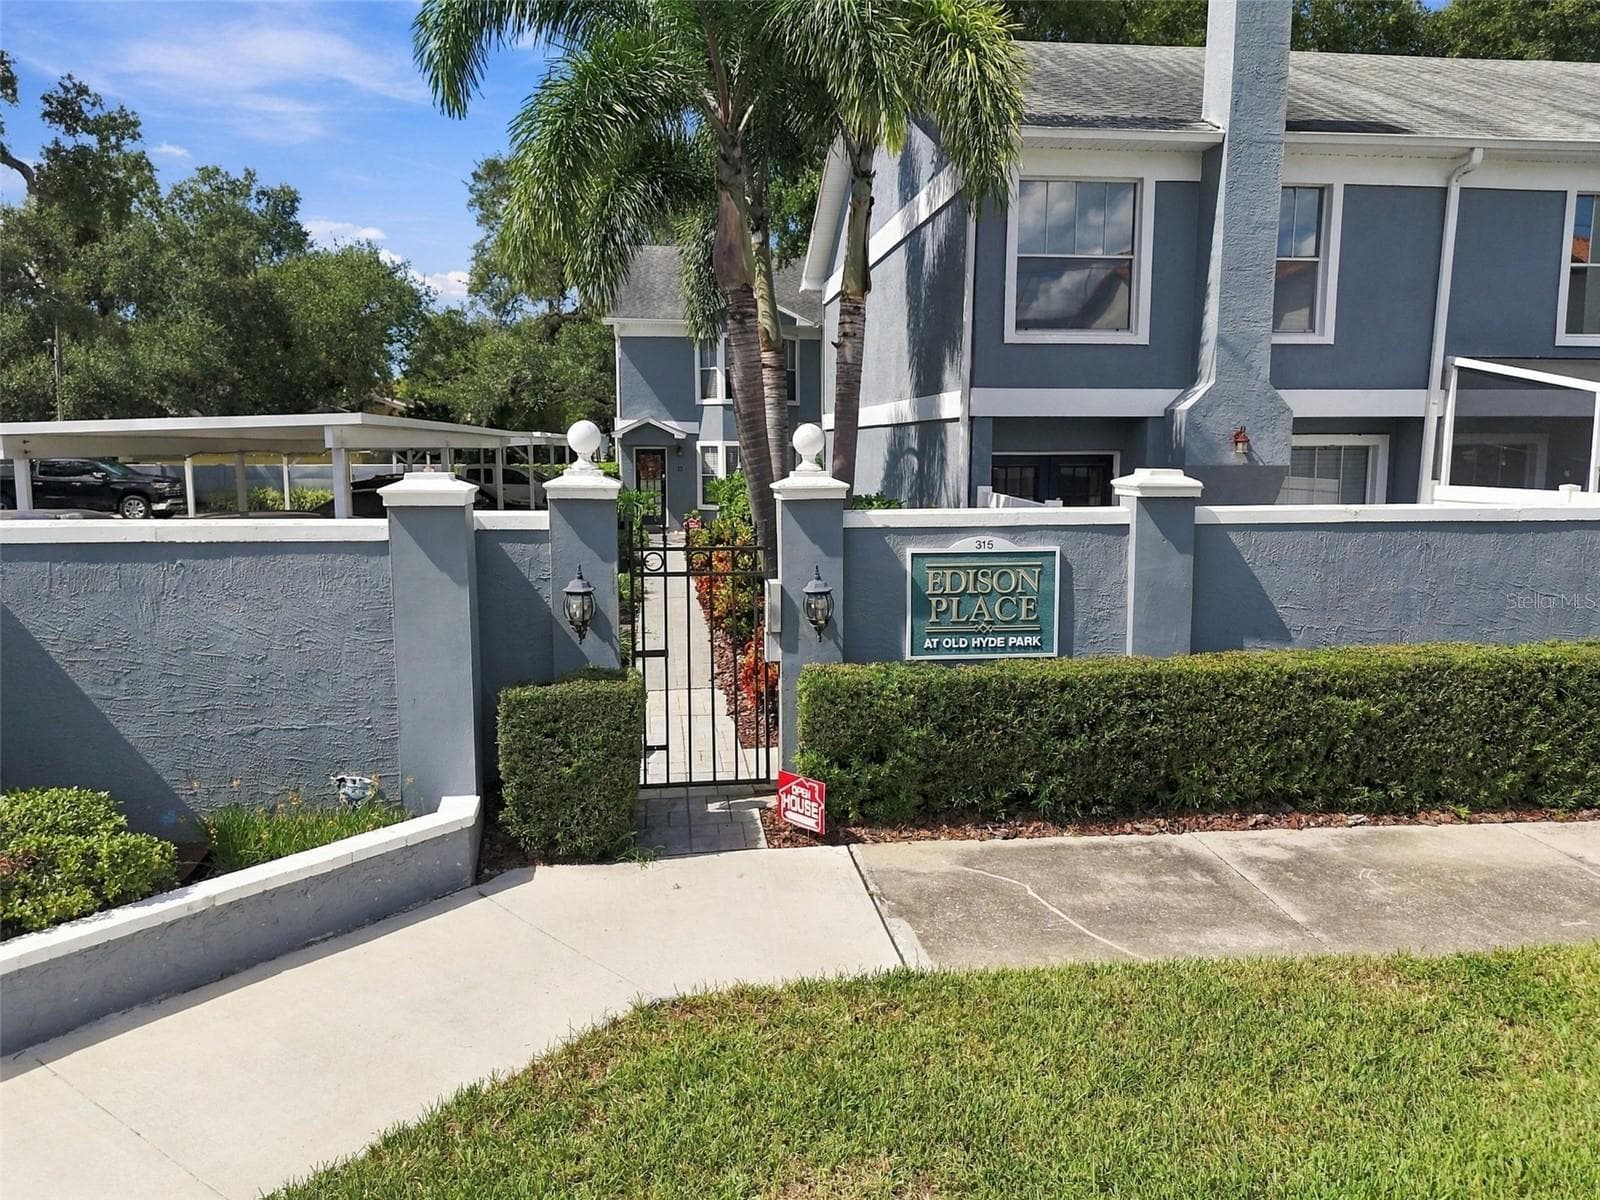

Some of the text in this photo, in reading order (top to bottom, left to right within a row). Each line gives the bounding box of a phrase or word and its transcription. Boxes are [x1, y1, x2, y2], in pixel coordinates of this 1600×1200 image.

[975, 540, 994, 550] 315
[926, 568, 1041, 594] EDISON
[928, 596, 1038, 623] PLACE
[924, 635, 1041, 649] AT OLD HYDE PARK
[791, 784, 811, 800] OPEN
[783, 791, 819, 819] HOUSE
